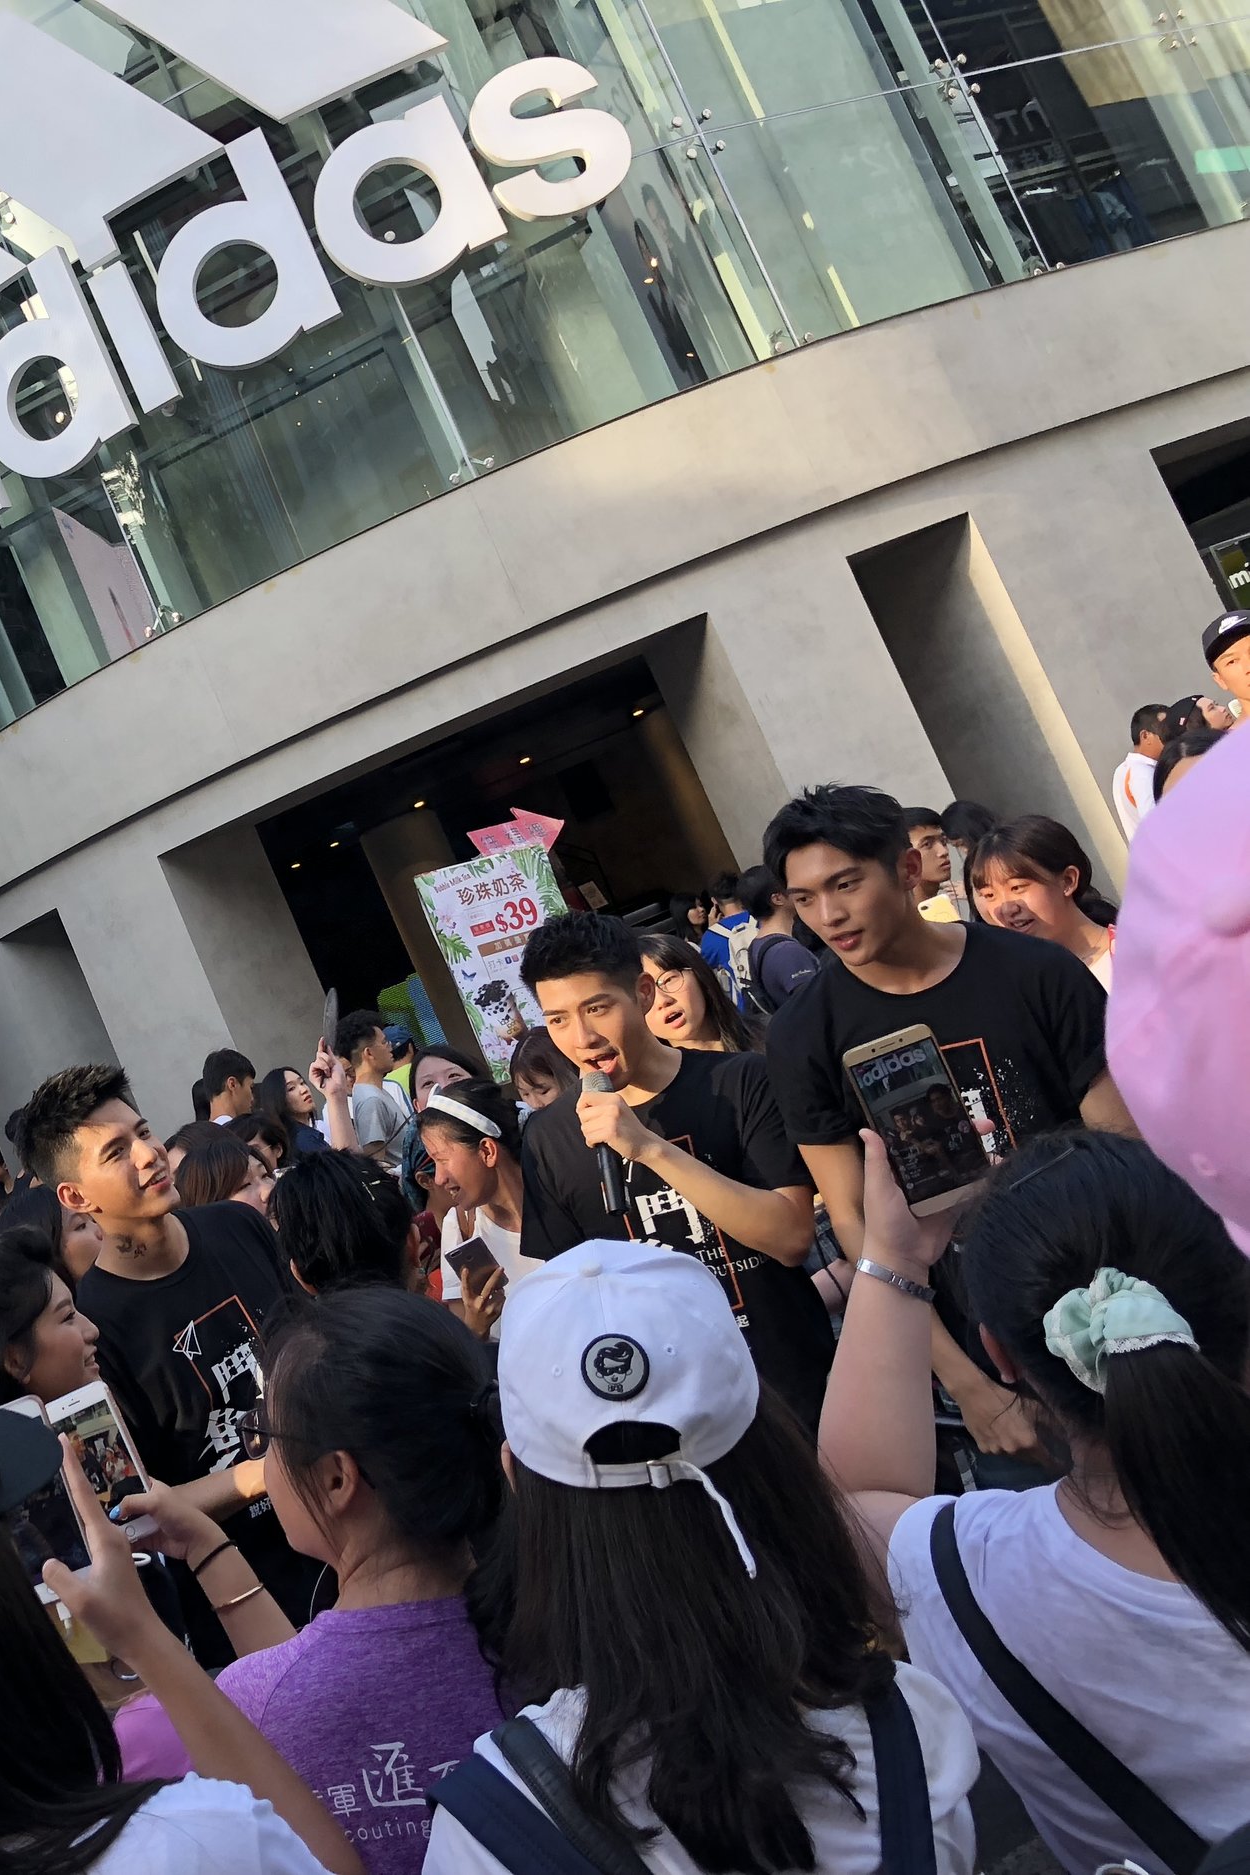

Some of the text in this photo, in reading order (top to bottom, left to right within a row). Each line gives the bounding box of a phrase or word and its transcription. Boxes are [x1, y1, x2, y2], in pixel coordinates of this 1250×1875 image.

[456, 872, 528, 906] 珍珠奶茶
[495, 897, 538, 934] $39
[695, 1246, 727, 1263] THE
